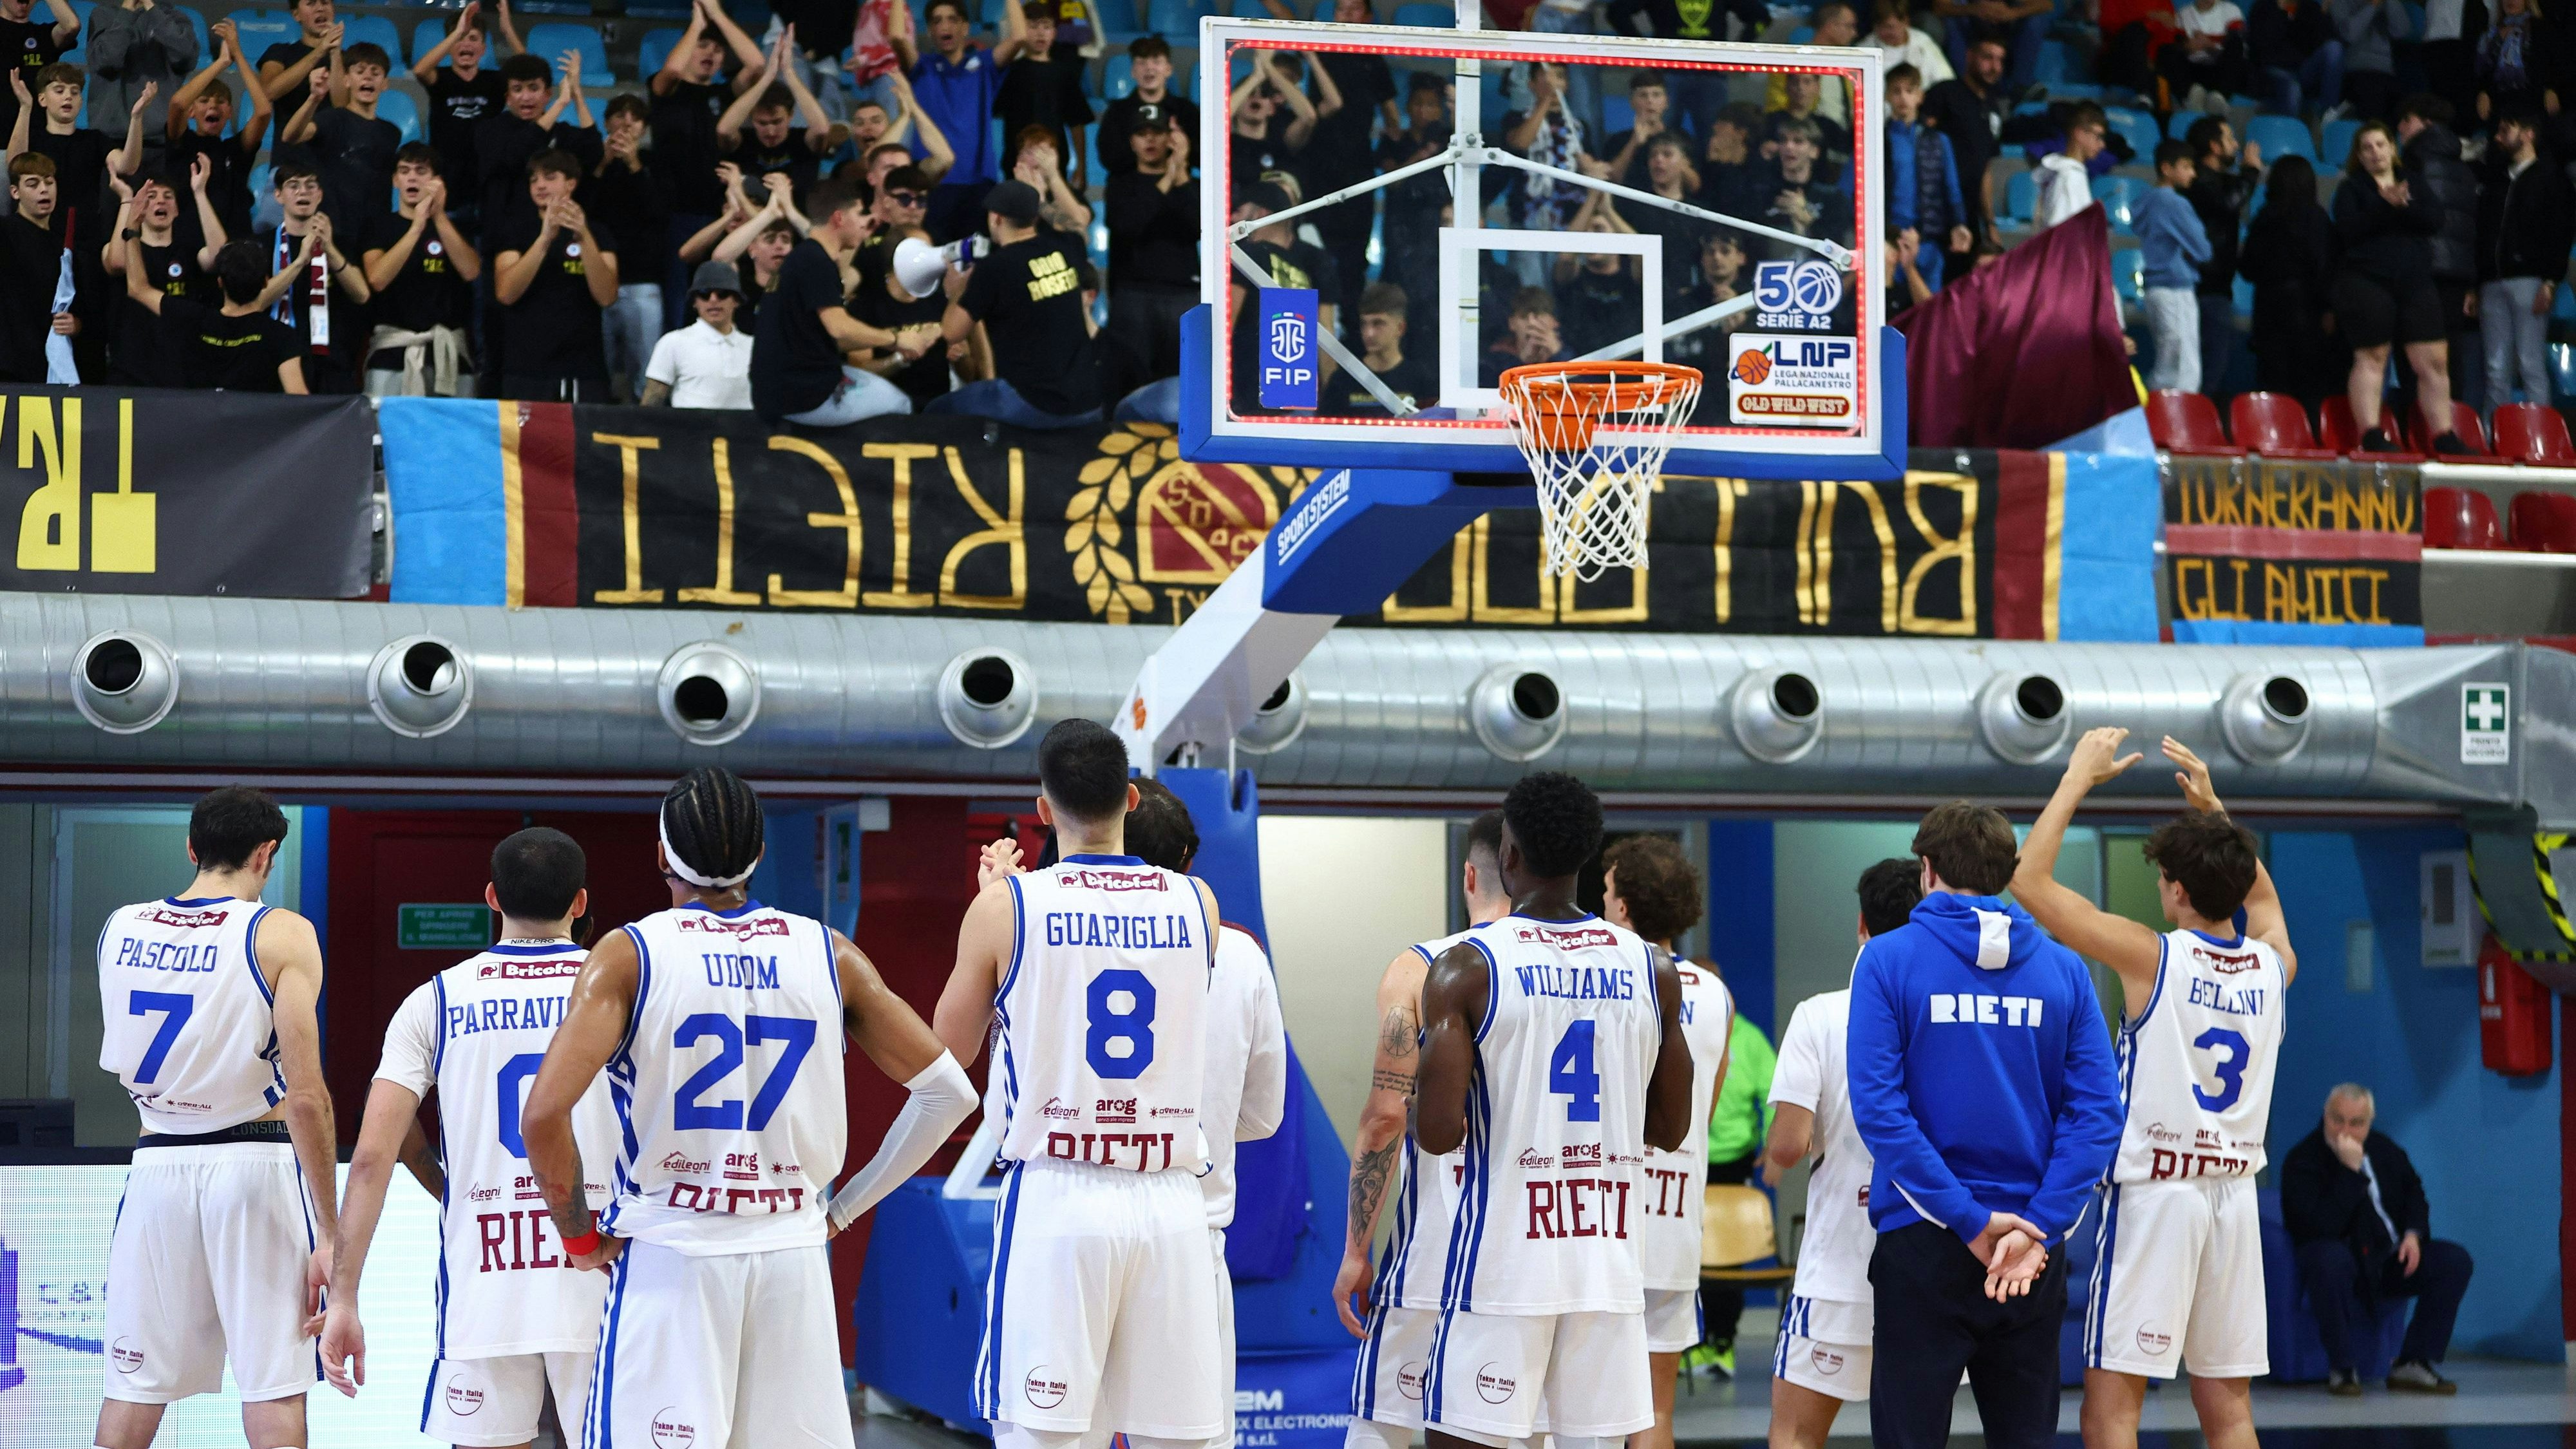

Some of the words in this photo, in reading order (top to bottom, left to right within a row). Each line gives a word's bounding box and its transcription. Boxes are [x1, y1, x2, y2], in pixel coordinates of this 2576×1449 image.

[1756, 312, 1804, 328] SERIE
[1808, 314, 1832, 330] A2
[1774, 340, 1851, 367] LNP
[1265, 368, 1311, 386] FIP
[1775, 370, 1797, 379] LEGA
[1800, 371, 1850, 379] NAZIONALE
[1775, 379, 1852, 389] PALLACANESTRO
[1741, 397, 1770, 411] OLD
[1771, 397, 1805, 413] WILD
[1806, 399, 1846, 414] WEST
[0, 395, 156, 573] TR
[592, 431, 1027, 609] RIETI
[2177, 559, 2251, 622] GLI
[2264, 562, 2391, 626] AMICI
[158, 911, 220, 926] Bricofer
[1046, 913, 1192, 949] GUARIGLIA
[117, 938, 218, 972] PASCOLO
[1542, 931, 1610, 949] Bicofer
[702, 954, 780, 990] UDOM
[1515, 965, 1633, 1000] WILLIAMS
[1930, 994, 2043, 1027] RIETI
[2188, 977, 2264, 1016] BELLINI
[448, 996, 571, 1039] PARRAVI
[1086, 969, 1157, 1079] 8
[129, 990, 193, 1084] 7
[674, 1013, 817, 1132] 27
[1549, 1019, 1599, 1122] 4
[2192, 1027, 2250, 1113] 3
[1096, 1097, 1137, 1115] arog
[663, 1159, 711, 1171] edileoni
[1562, 1142, 1602, 1159] arog
[1526, 1179, 1630, 1240] RIETI
